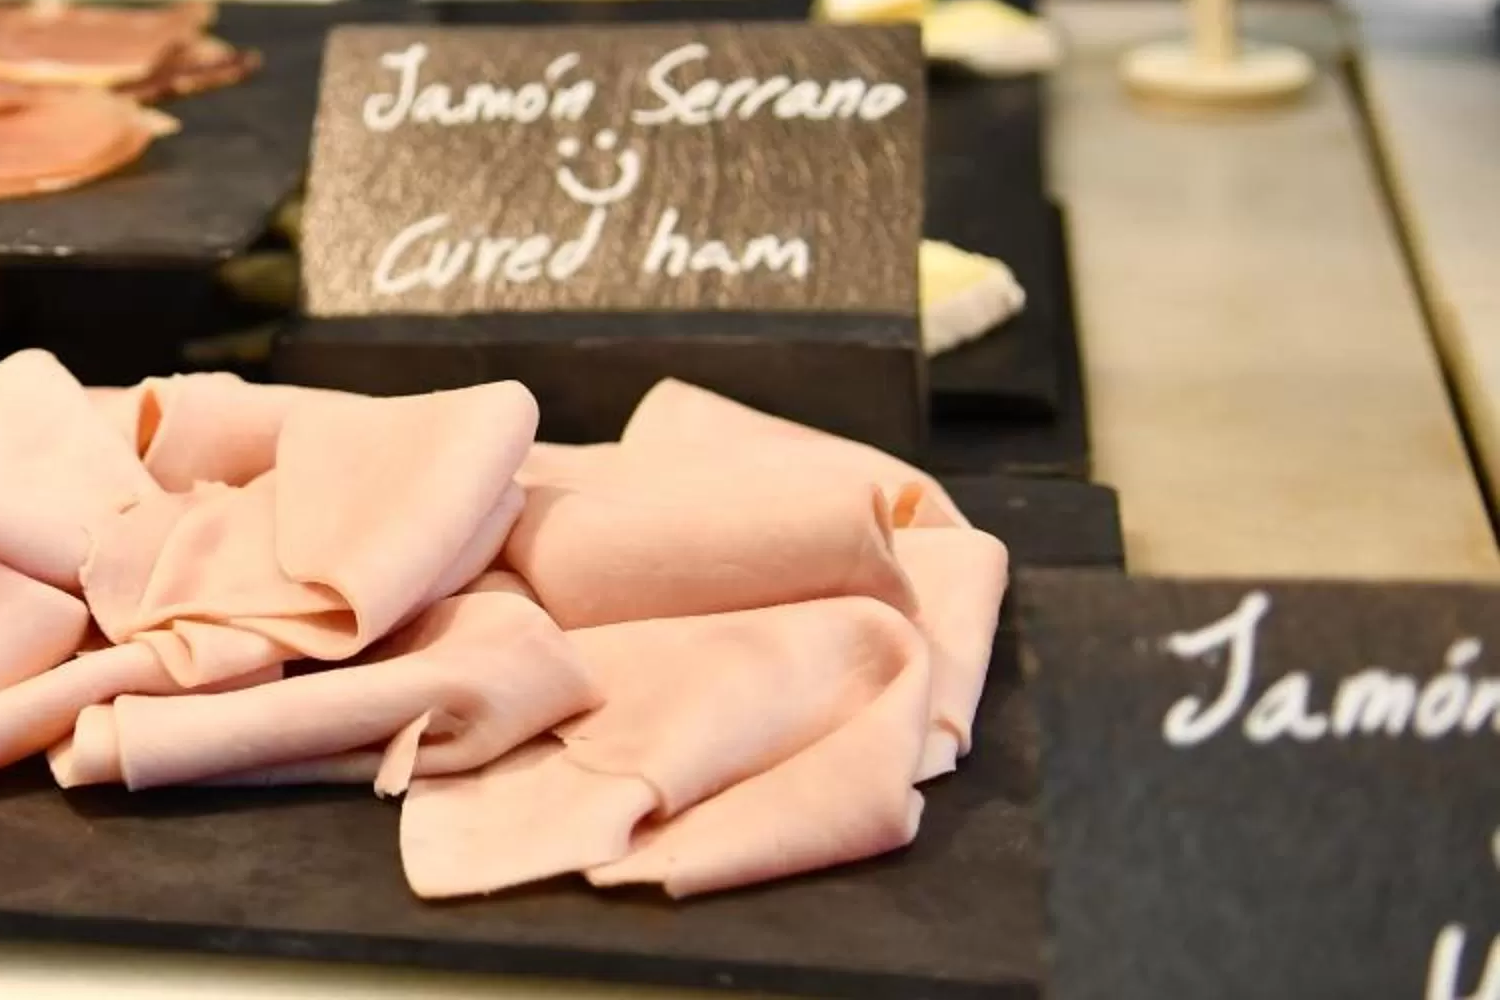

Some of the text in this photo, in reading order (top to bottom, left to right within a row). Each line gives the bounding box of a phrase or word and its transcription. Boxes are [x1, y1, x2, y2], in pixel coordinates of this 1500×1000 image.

[363, 42, 908, 131] Jamón Serrano
[370, 206, 811, 297] Cured ham
